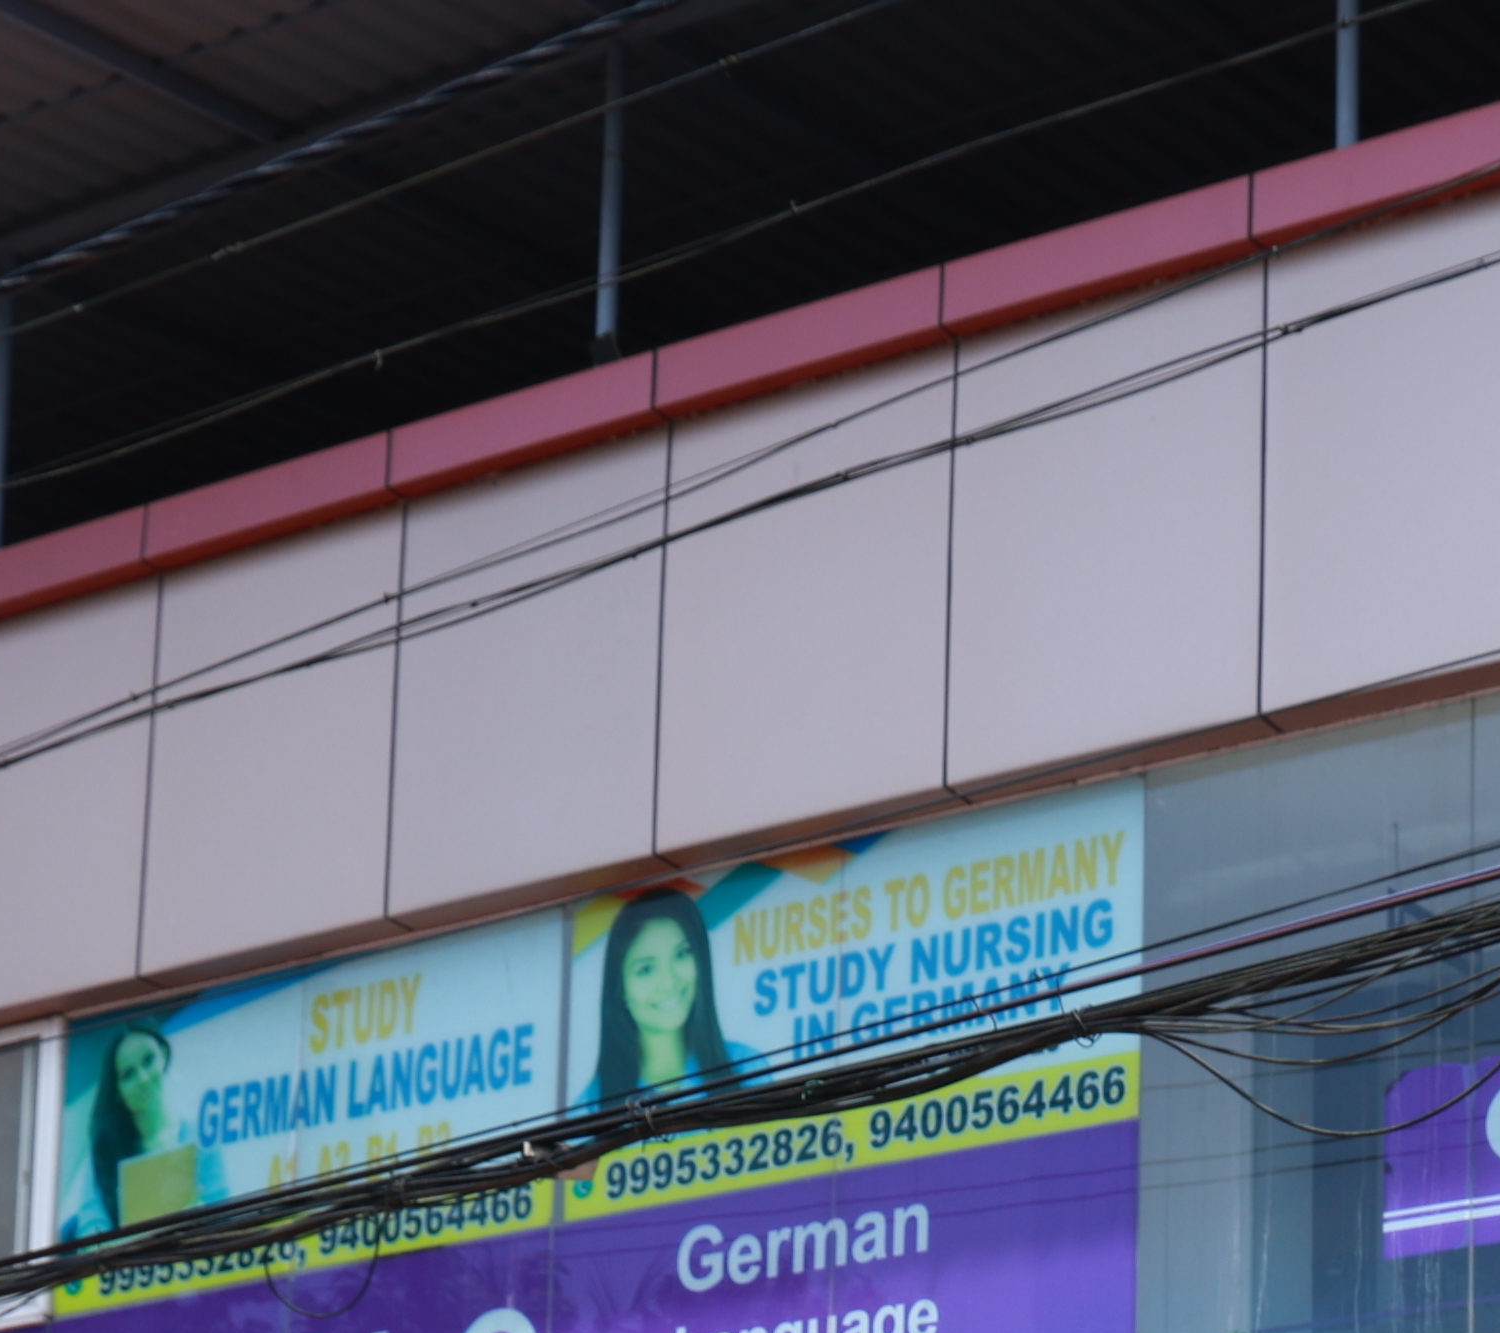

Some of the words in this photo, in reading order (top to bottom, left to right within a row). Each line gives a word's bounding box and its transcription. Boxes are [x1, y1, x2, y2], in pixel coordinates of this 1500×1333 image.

[733, 890, 873, 965] NURSES
[884, 873, 931, 930] TO
[943, 831, 1126, 920] GERMANY
[753, 942, 896, 1018] STUDY
[910, 899, 1114, 984] NURSING
[309, 973, 423, 1055] STUDY
[200, 1063, 339, 1149] GERMAN
[348, 1023, 535, 1120] LANGUAGE
[605, 1117, 856, 1201] 9995332826,
[869, 1065, 1127, 1149] 9400564466
[676, 1202, 931, 1294] German
